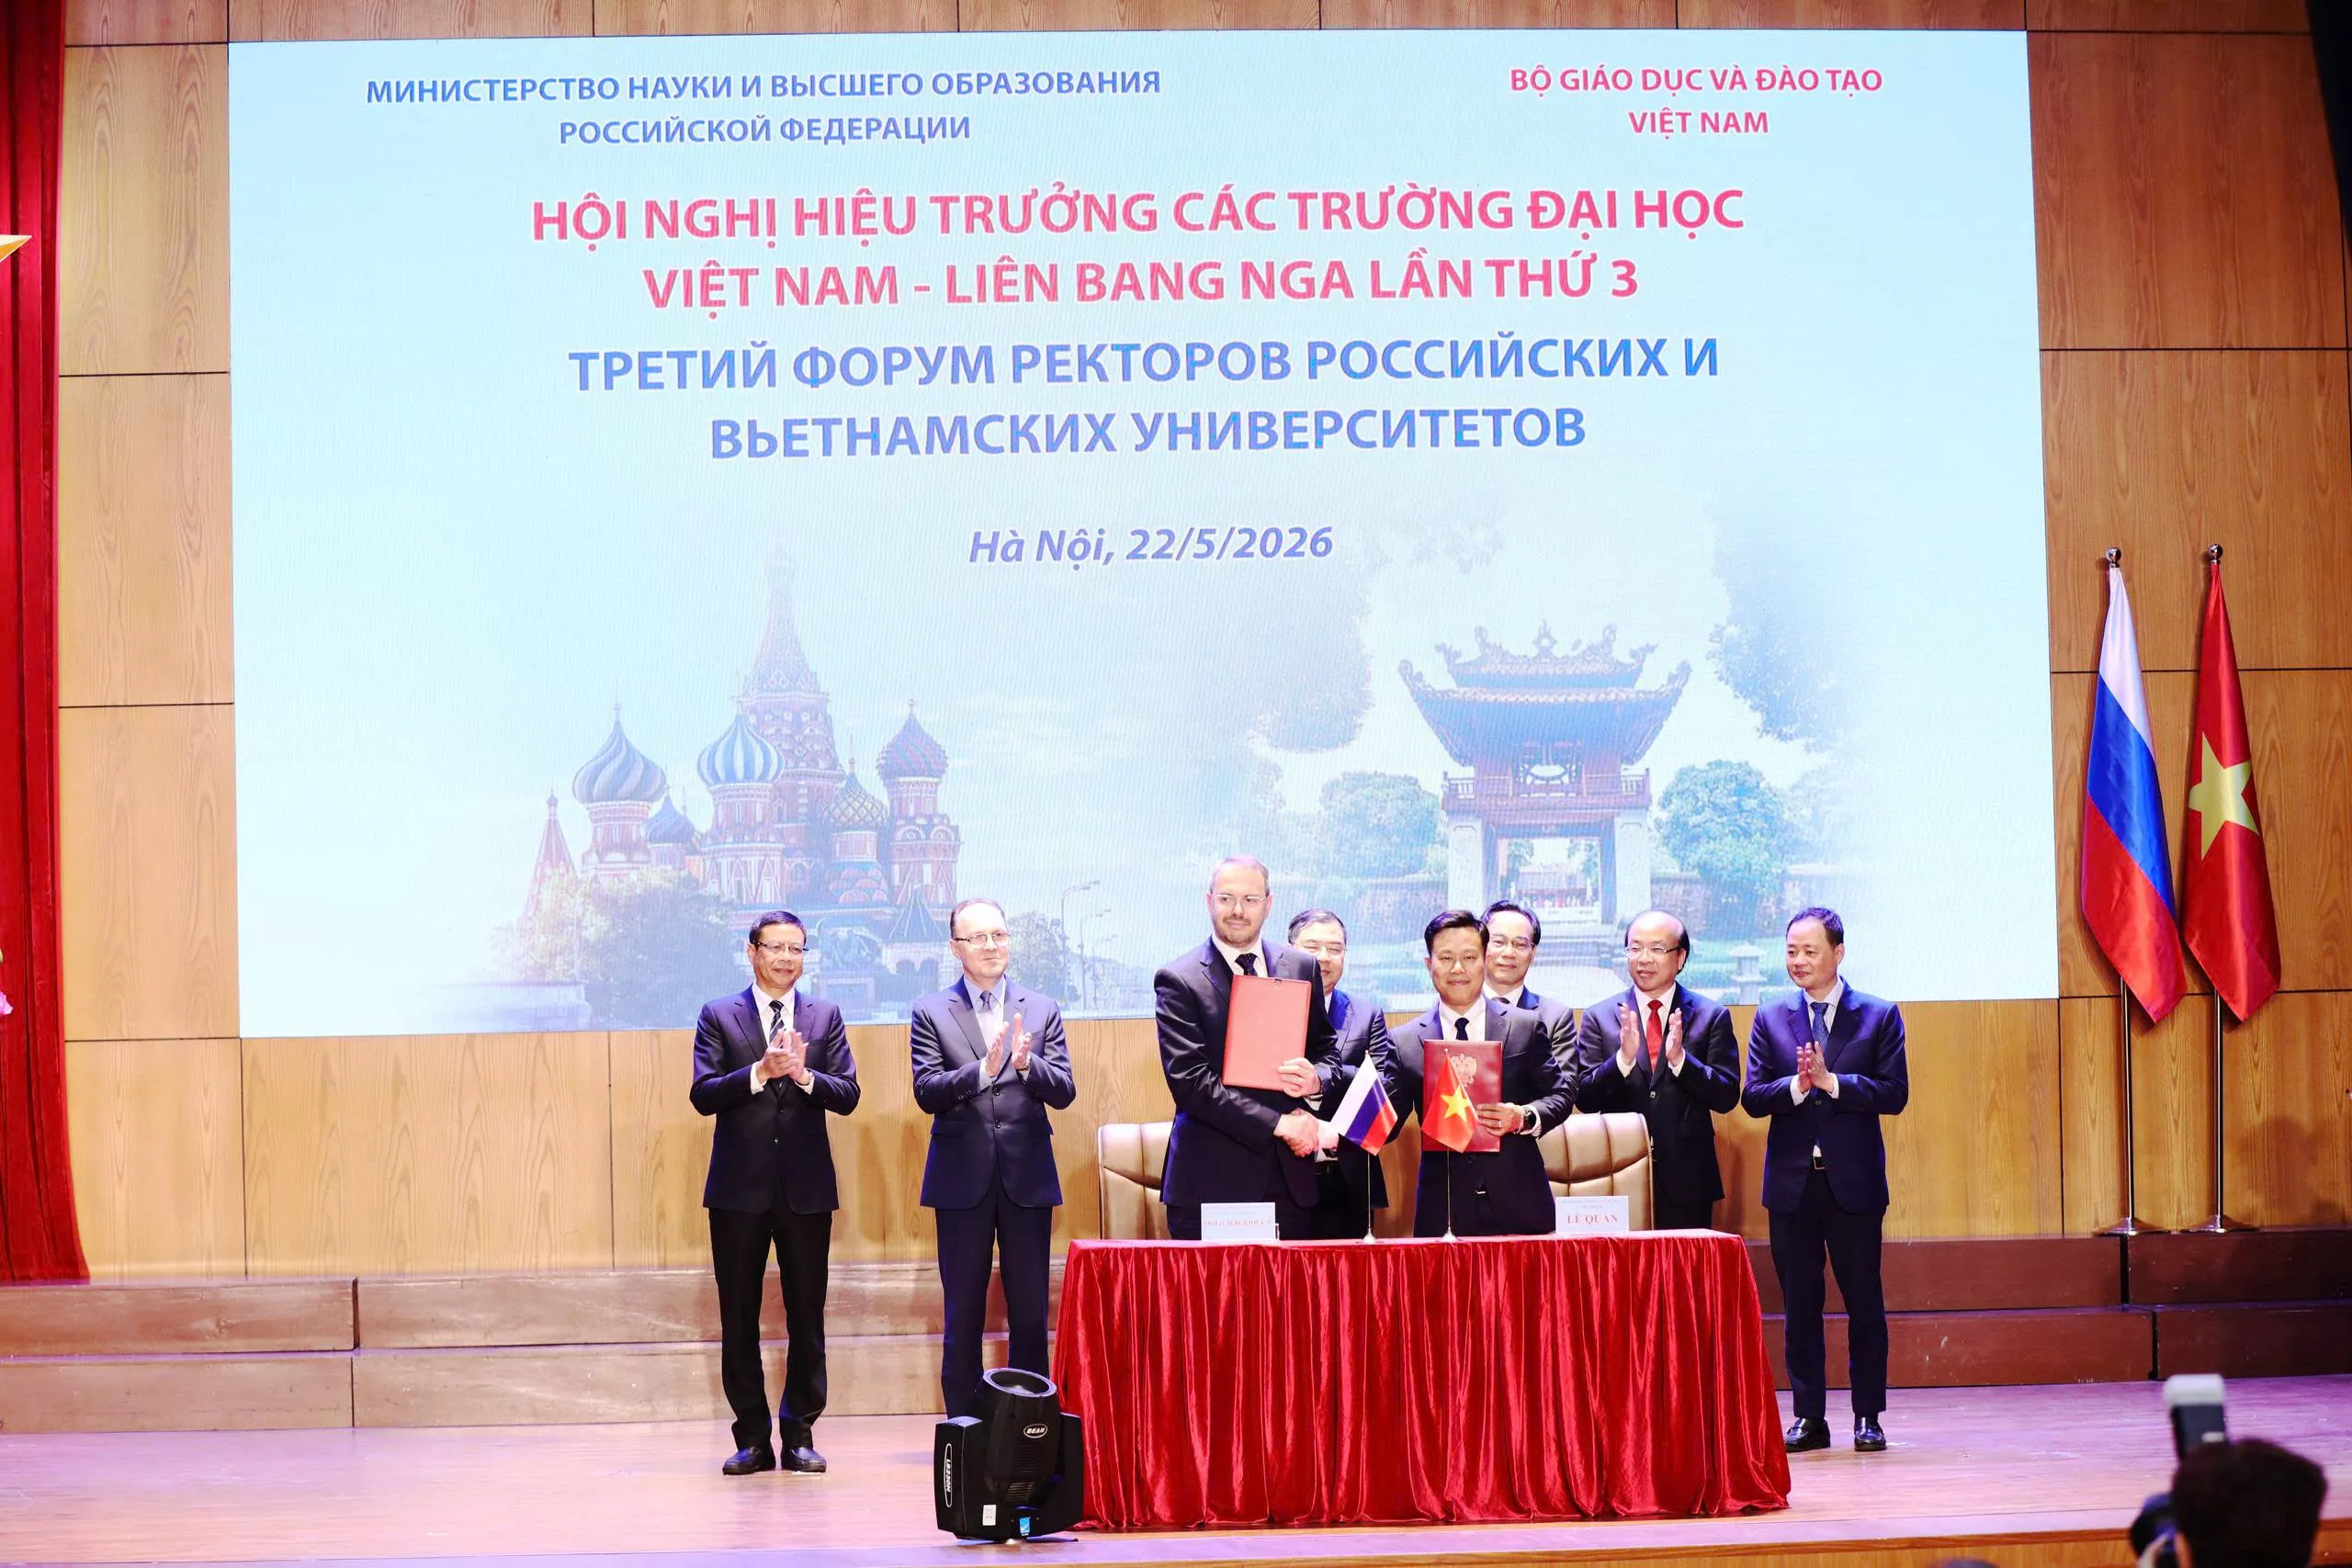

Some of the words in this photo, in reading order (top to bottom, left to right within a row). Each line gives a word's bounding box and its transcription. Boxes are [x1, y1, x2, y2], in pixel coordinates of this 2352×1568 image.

[367, 77, 620, 104] МИНИСТЕРСТВО
[628, 75, 731, 99] НАУКИ
[741, 75, 762, 98] И
[771, 73, 923, 97] ВЫСШЕГО
[932, 71, 1160, 96] ОБРАЗОВАНИЯ
[1510, 63, 1552, 97] BỘ
[1559, 63, 1634, 92] GIÁO
[1641, 68, 1703, 97] DỤC
[1708, 64, 1748, 91] VÀ
[1754, 64, 1820, 92] ĐÀO
[1825, 69, 1883, 98] TẠO
[560, 114, 771, 144] РОССИЙСКОЙ
[780, 117, 970, 146] ФЕДЕРАЦИИ
[1628, 107, 1692, 141] VIỆT
[1700, 111, 1769, 133] NAM
[533, 192, 627, 252] HỘI
[644, 197, 776, 249] NGHỊ
[794, 187, 916, 247] HIỆU
[929, 182, 1158, 234] TRƯỞNG
[1172, 183, 1276, 232] CÁC
[1286, 182, 1513, 231] TRƯỜNG
[1526, 189, 1618, 241] ĐẠI
[1634, 189, 1745, 240] HỌC
[642, 259, 760, 320] VIỆT
[775, 265, 899, 307] NAM
[912, 283, 932, 294] -
[946, 254, 1059, 304] LIÊN
[1076, 261, 1225, 302] BANG
[1240, 260, 1355, 300] NGA
[1370, 246, 1473, 299] LẦN
[1484, 250, 1598, 298] THỨ
[1611, 259, 1638, 298] 3
[568, 340, 776, 391] ТРЕТИЙ
[793, 344, 995, 389] ФОРУМ
[1012, 341, 1292, 384] РЕКТОРОВ
[1307, 331, 1669, 380] РОССИЙСКИХ
[1683, 337, 1718, 377] И
[711, 412, 1117, 459] ВЬЕТНАМСКИХ
[1130, 407, 1586, 452] УНИВЕРСИТЕТОВ
[969, 529, 1025, 563] Hà
[1035, 528, 1114, 571] Nội,
[1125, 525, 1333, 561] 22/5/2026
